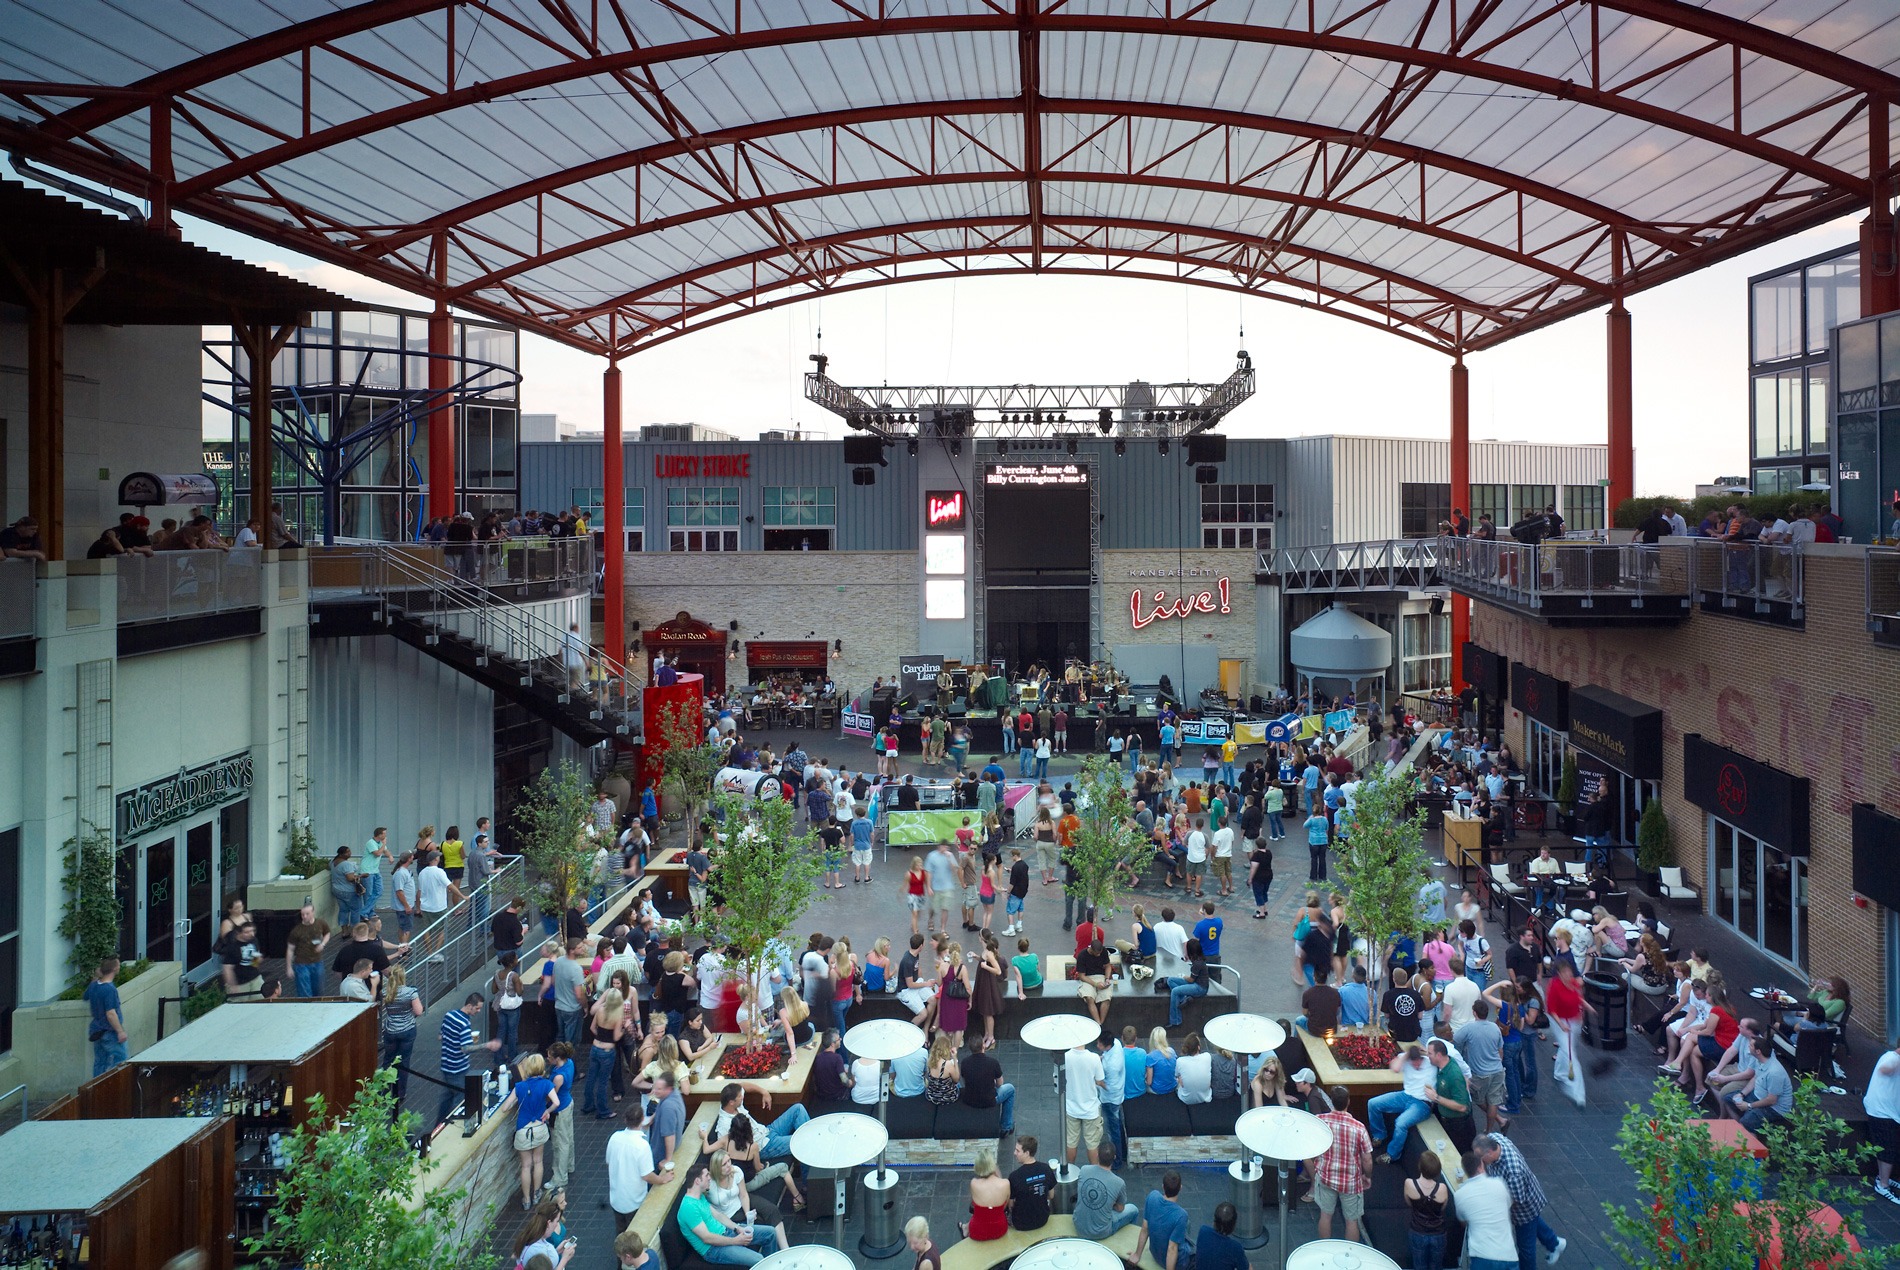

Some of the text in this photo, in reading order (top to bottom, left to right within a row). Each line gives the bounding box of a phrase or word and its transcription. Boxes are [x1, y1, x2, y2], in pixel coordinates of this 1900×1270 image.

[655, 453, 751, 478] LUCKY STRIKE
[995, 465, 1078, 475] Everclear, June 4th
[987, 474, 1087, 485] Billy Currington June 5
[1129, 569, 1184, 577] KANSAS
[1130, 577, 1231, 629] Live!
[660, 632, 707, 640] Raglan Road
[902, 663, 941, 674] Carolina
[916, 672, 937, 681] Liar
[1573, 719, 1602, 742] Maker's
[1602, 732, 1626, 756] Mark
[128, 757, 255, 835] McFADDEN'S
[191, 790, 226, 810] SALOON
[1208, 926, 1217, 940] 6
